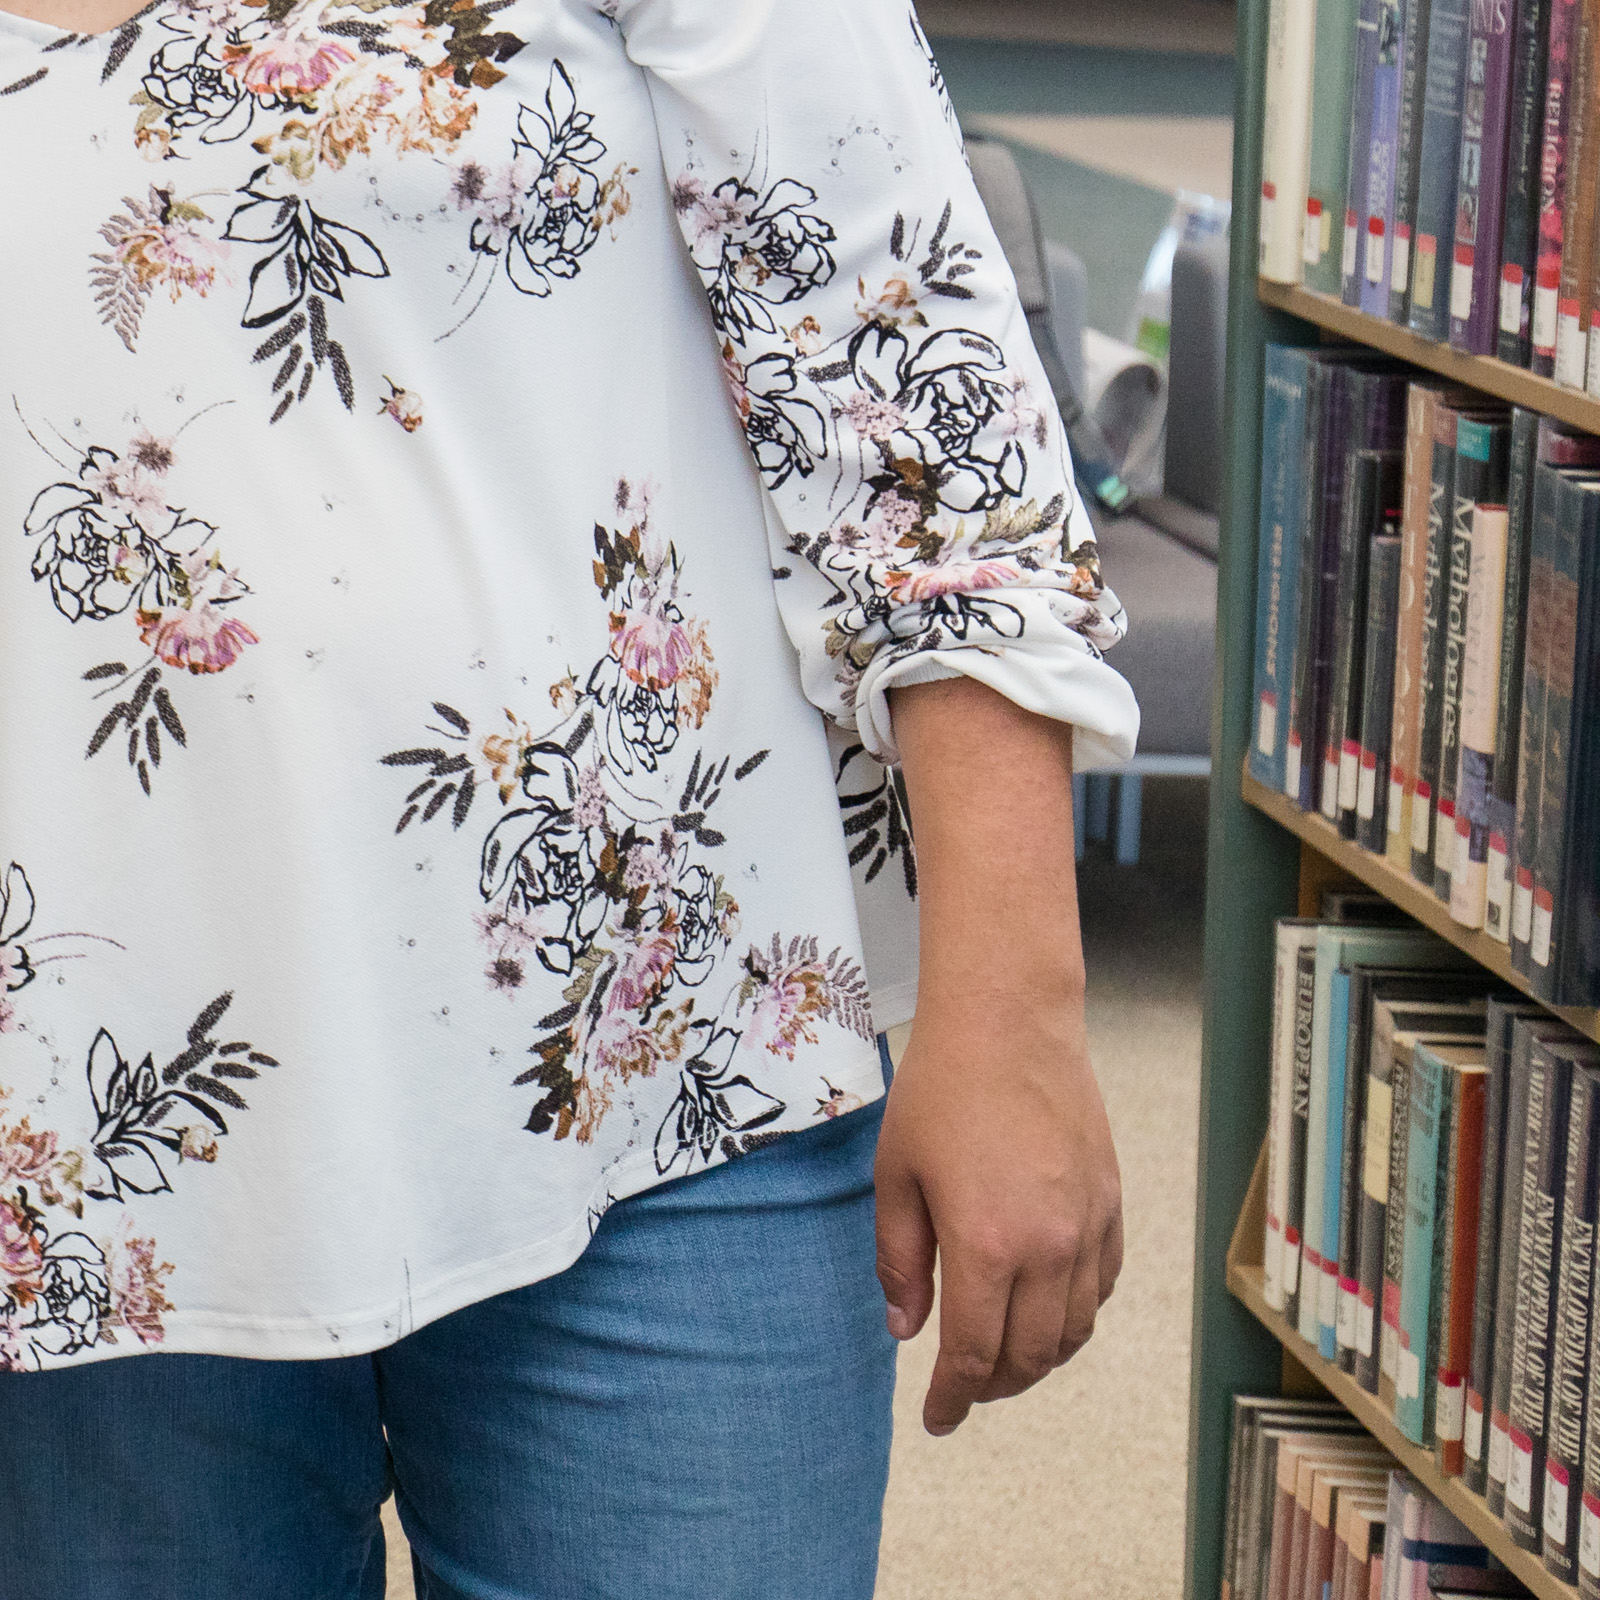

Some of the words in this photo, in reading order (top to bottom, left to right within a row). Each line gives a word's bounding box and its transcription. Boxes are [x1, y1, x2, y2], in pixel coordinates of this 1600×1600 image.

[1541, 80, 1562, 216] RELIGION
[1266, 523, 1284, 679] RELIGIONS
[1443, 495, 1476, 749] Mythologies
[1294, 971, 1313, 1119] EUROPEAN
[1526, 1055, 1545, 1174] AMERICAN
[1517, 1169, 1537, 1286] RELIGIOUS
[1527, 1190, 1555, 1351] ENCYCLOPEDIA
[1561, 1215, 1593, 1379] ENCYCLOPEDIA
[1523, 1387, 1543, 1437] THE
[1527, 1351, 1546, 1388] OF
[1561, 1380, 1583, 1418] OF
[1558, 1414, 1580, 1466] THE
